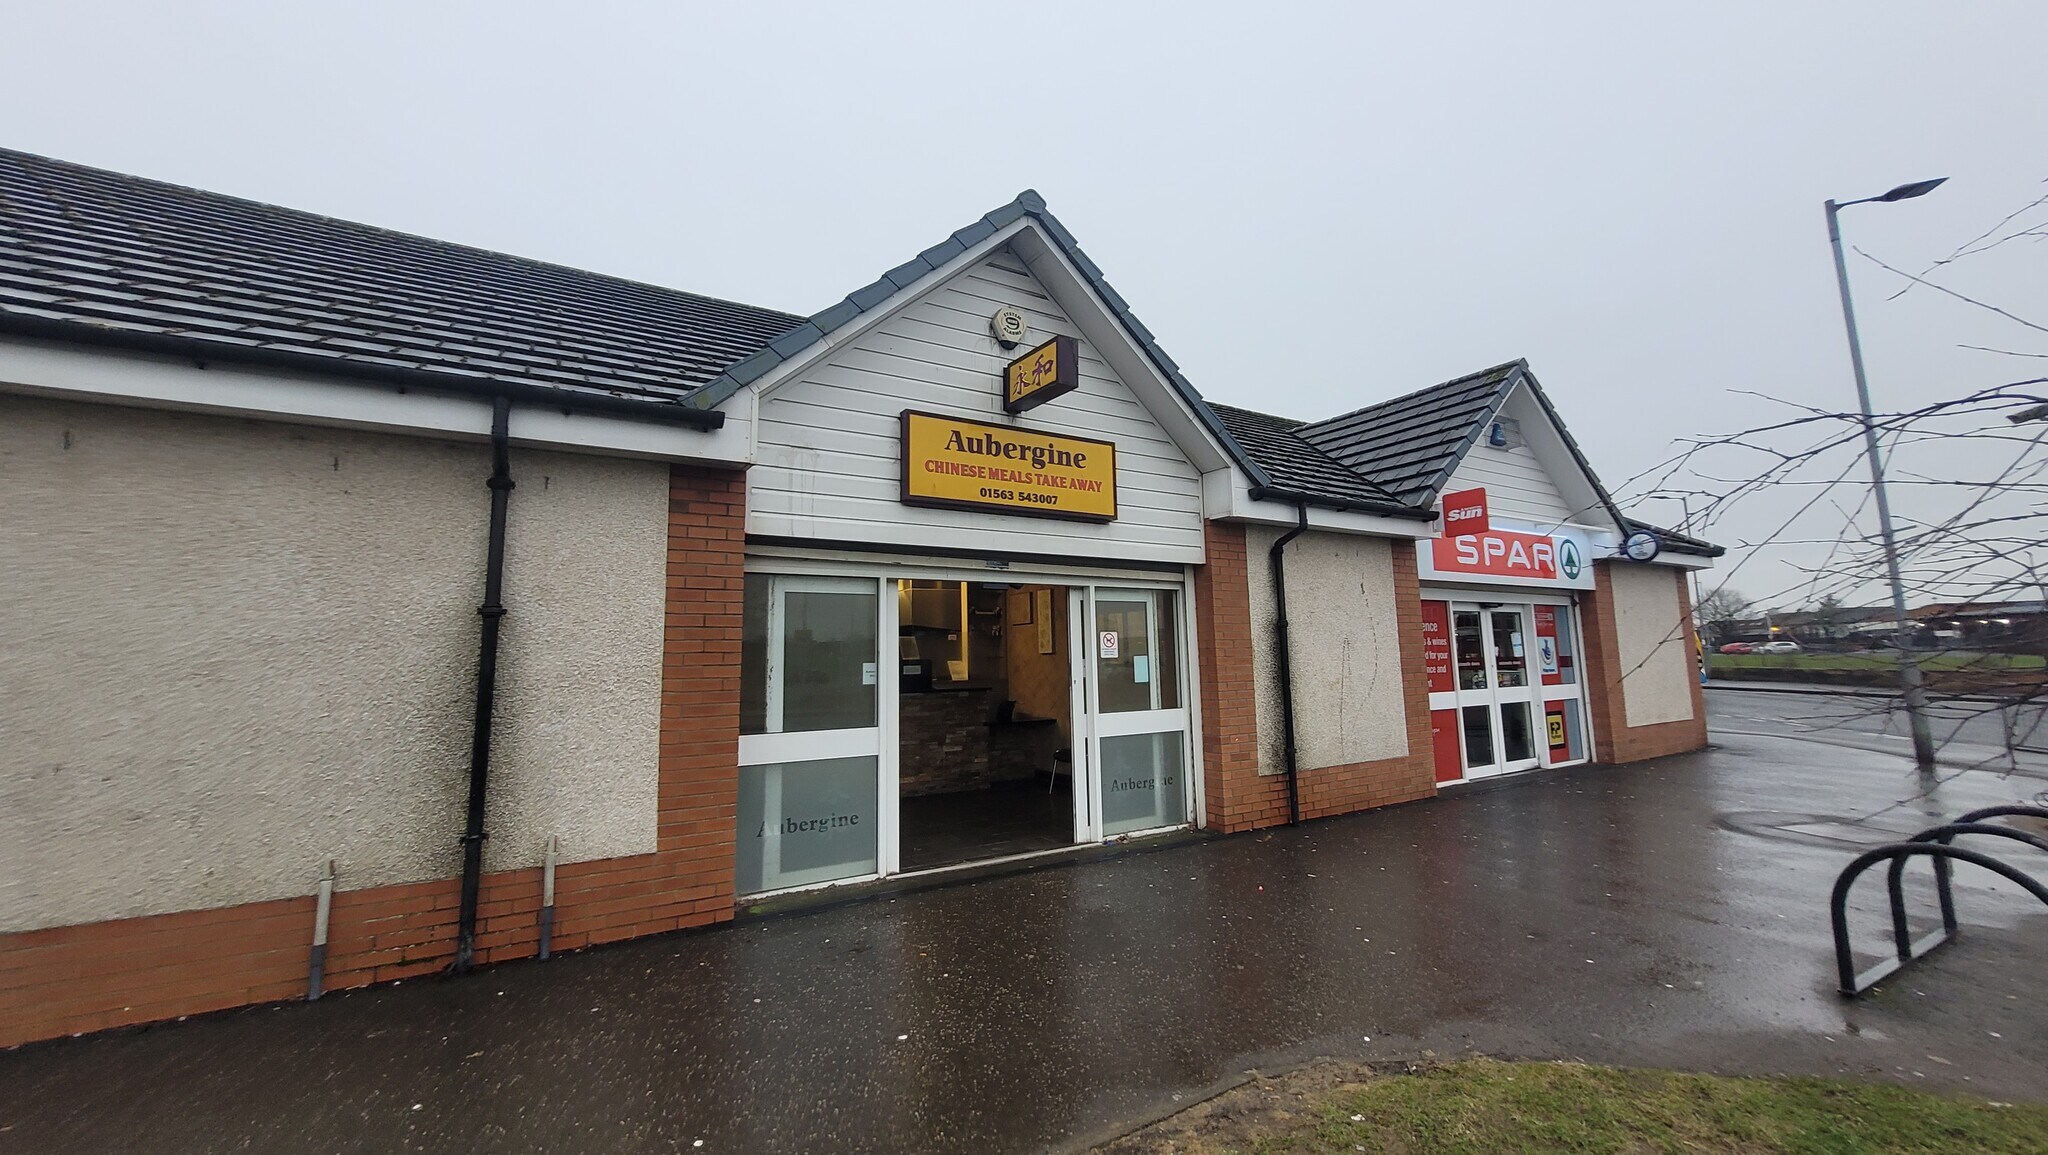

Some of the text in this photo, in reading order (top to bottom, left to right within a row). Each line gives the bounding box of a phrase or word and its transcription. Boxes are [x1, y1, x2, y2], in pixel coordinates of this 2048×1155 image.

[1003, 311, 1022, 320] SYSTEM
[1005, 317, 1020, 330] 9
[1003, 326, 1022, 336] ALARMS
[1012, 353, 1054, 396] 永和
[944, 430, 1087, 470] Aubergine
[924, 459, 1103, 493] CHINESE MEALS TAKE AWAY
[979, 487, 1059, 505] 01563 543007
[1447, 506, 1483, 522] Sun
[1455, 534, 1556, 573] SPAR
[1432, 637, 1447, 646] wines
[1110, 776, 1173, 793] Aubergne
